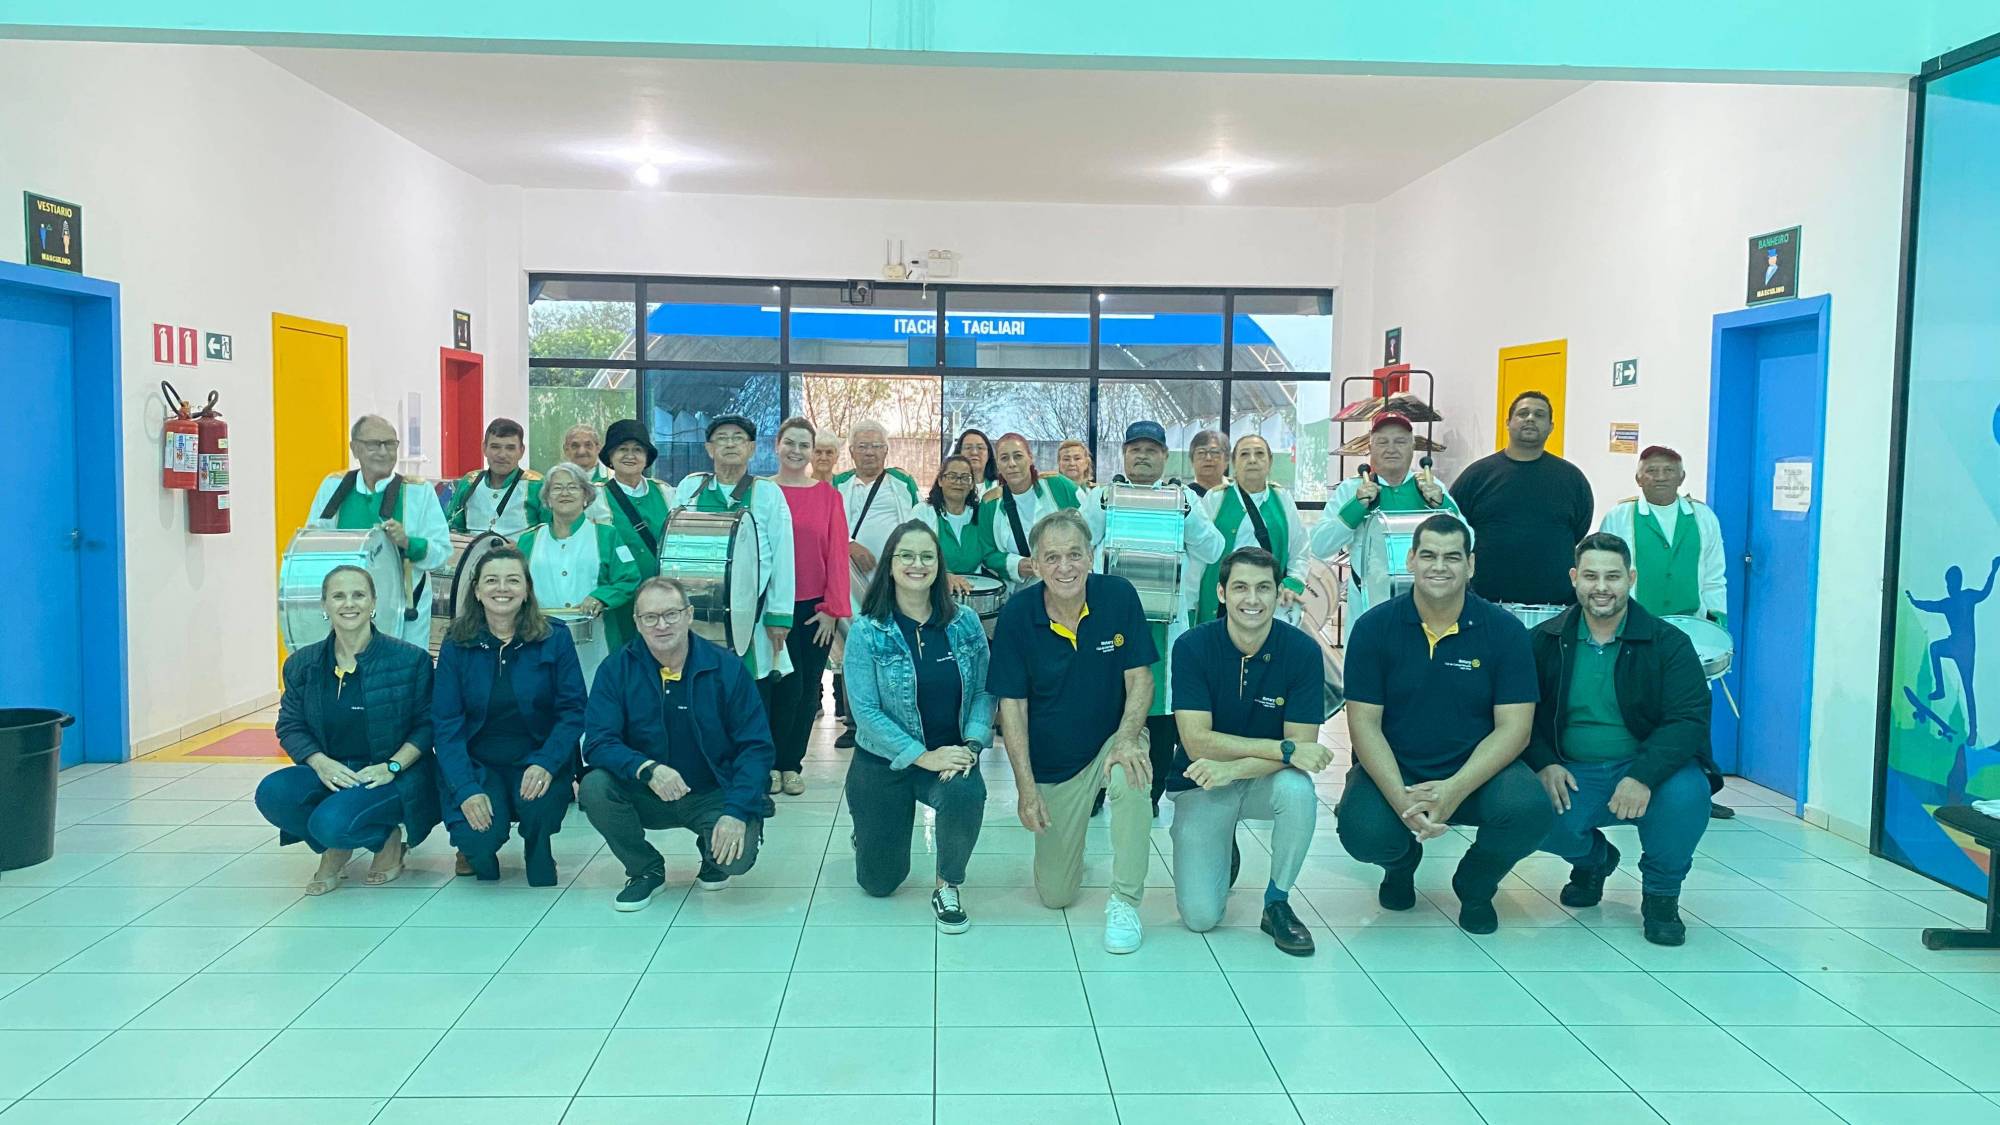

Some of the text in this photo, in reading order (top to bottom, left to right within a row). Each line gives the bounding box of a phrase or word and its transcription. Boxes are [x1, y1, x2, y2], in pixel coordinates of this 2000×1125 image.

[37, 200, 72, 218] VESTIARIO
[1758, 233, 1789, 249] BANHEIRO
[894, 319, 1025, 335] ITACHR TAGLIARI
